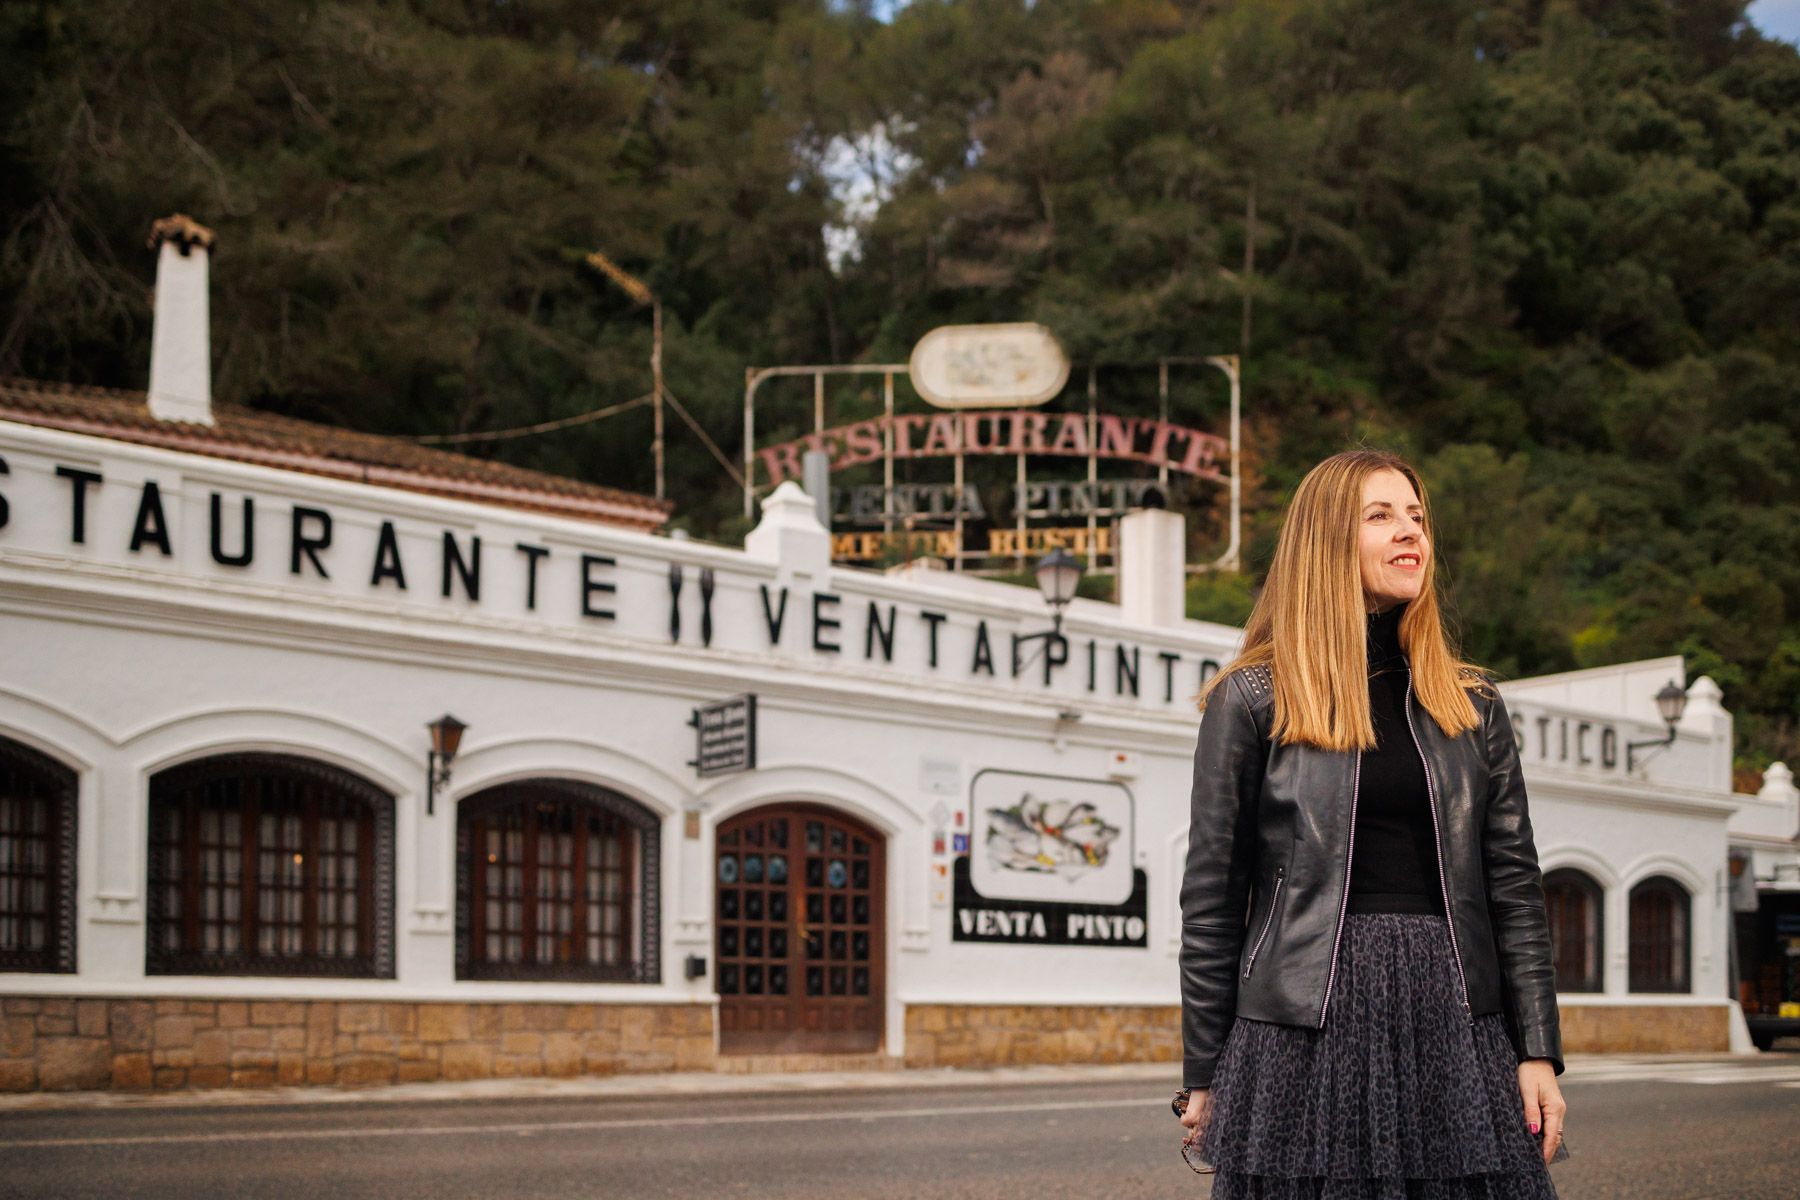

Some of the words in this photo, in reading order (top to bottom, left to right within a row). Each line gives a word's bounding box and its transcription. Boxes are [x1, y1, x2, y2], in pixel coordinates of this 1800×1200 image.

[988, 527, 1110, 556] RUSTI
[0, 457, 616, 620] TAURANTE
[760, 584, 995, 676] VENTA
[1509, 711, 1617, 768] STICO
[958, 908, 1046, 937] VENTA
[1066, 913, 1145, 940] PINTO
